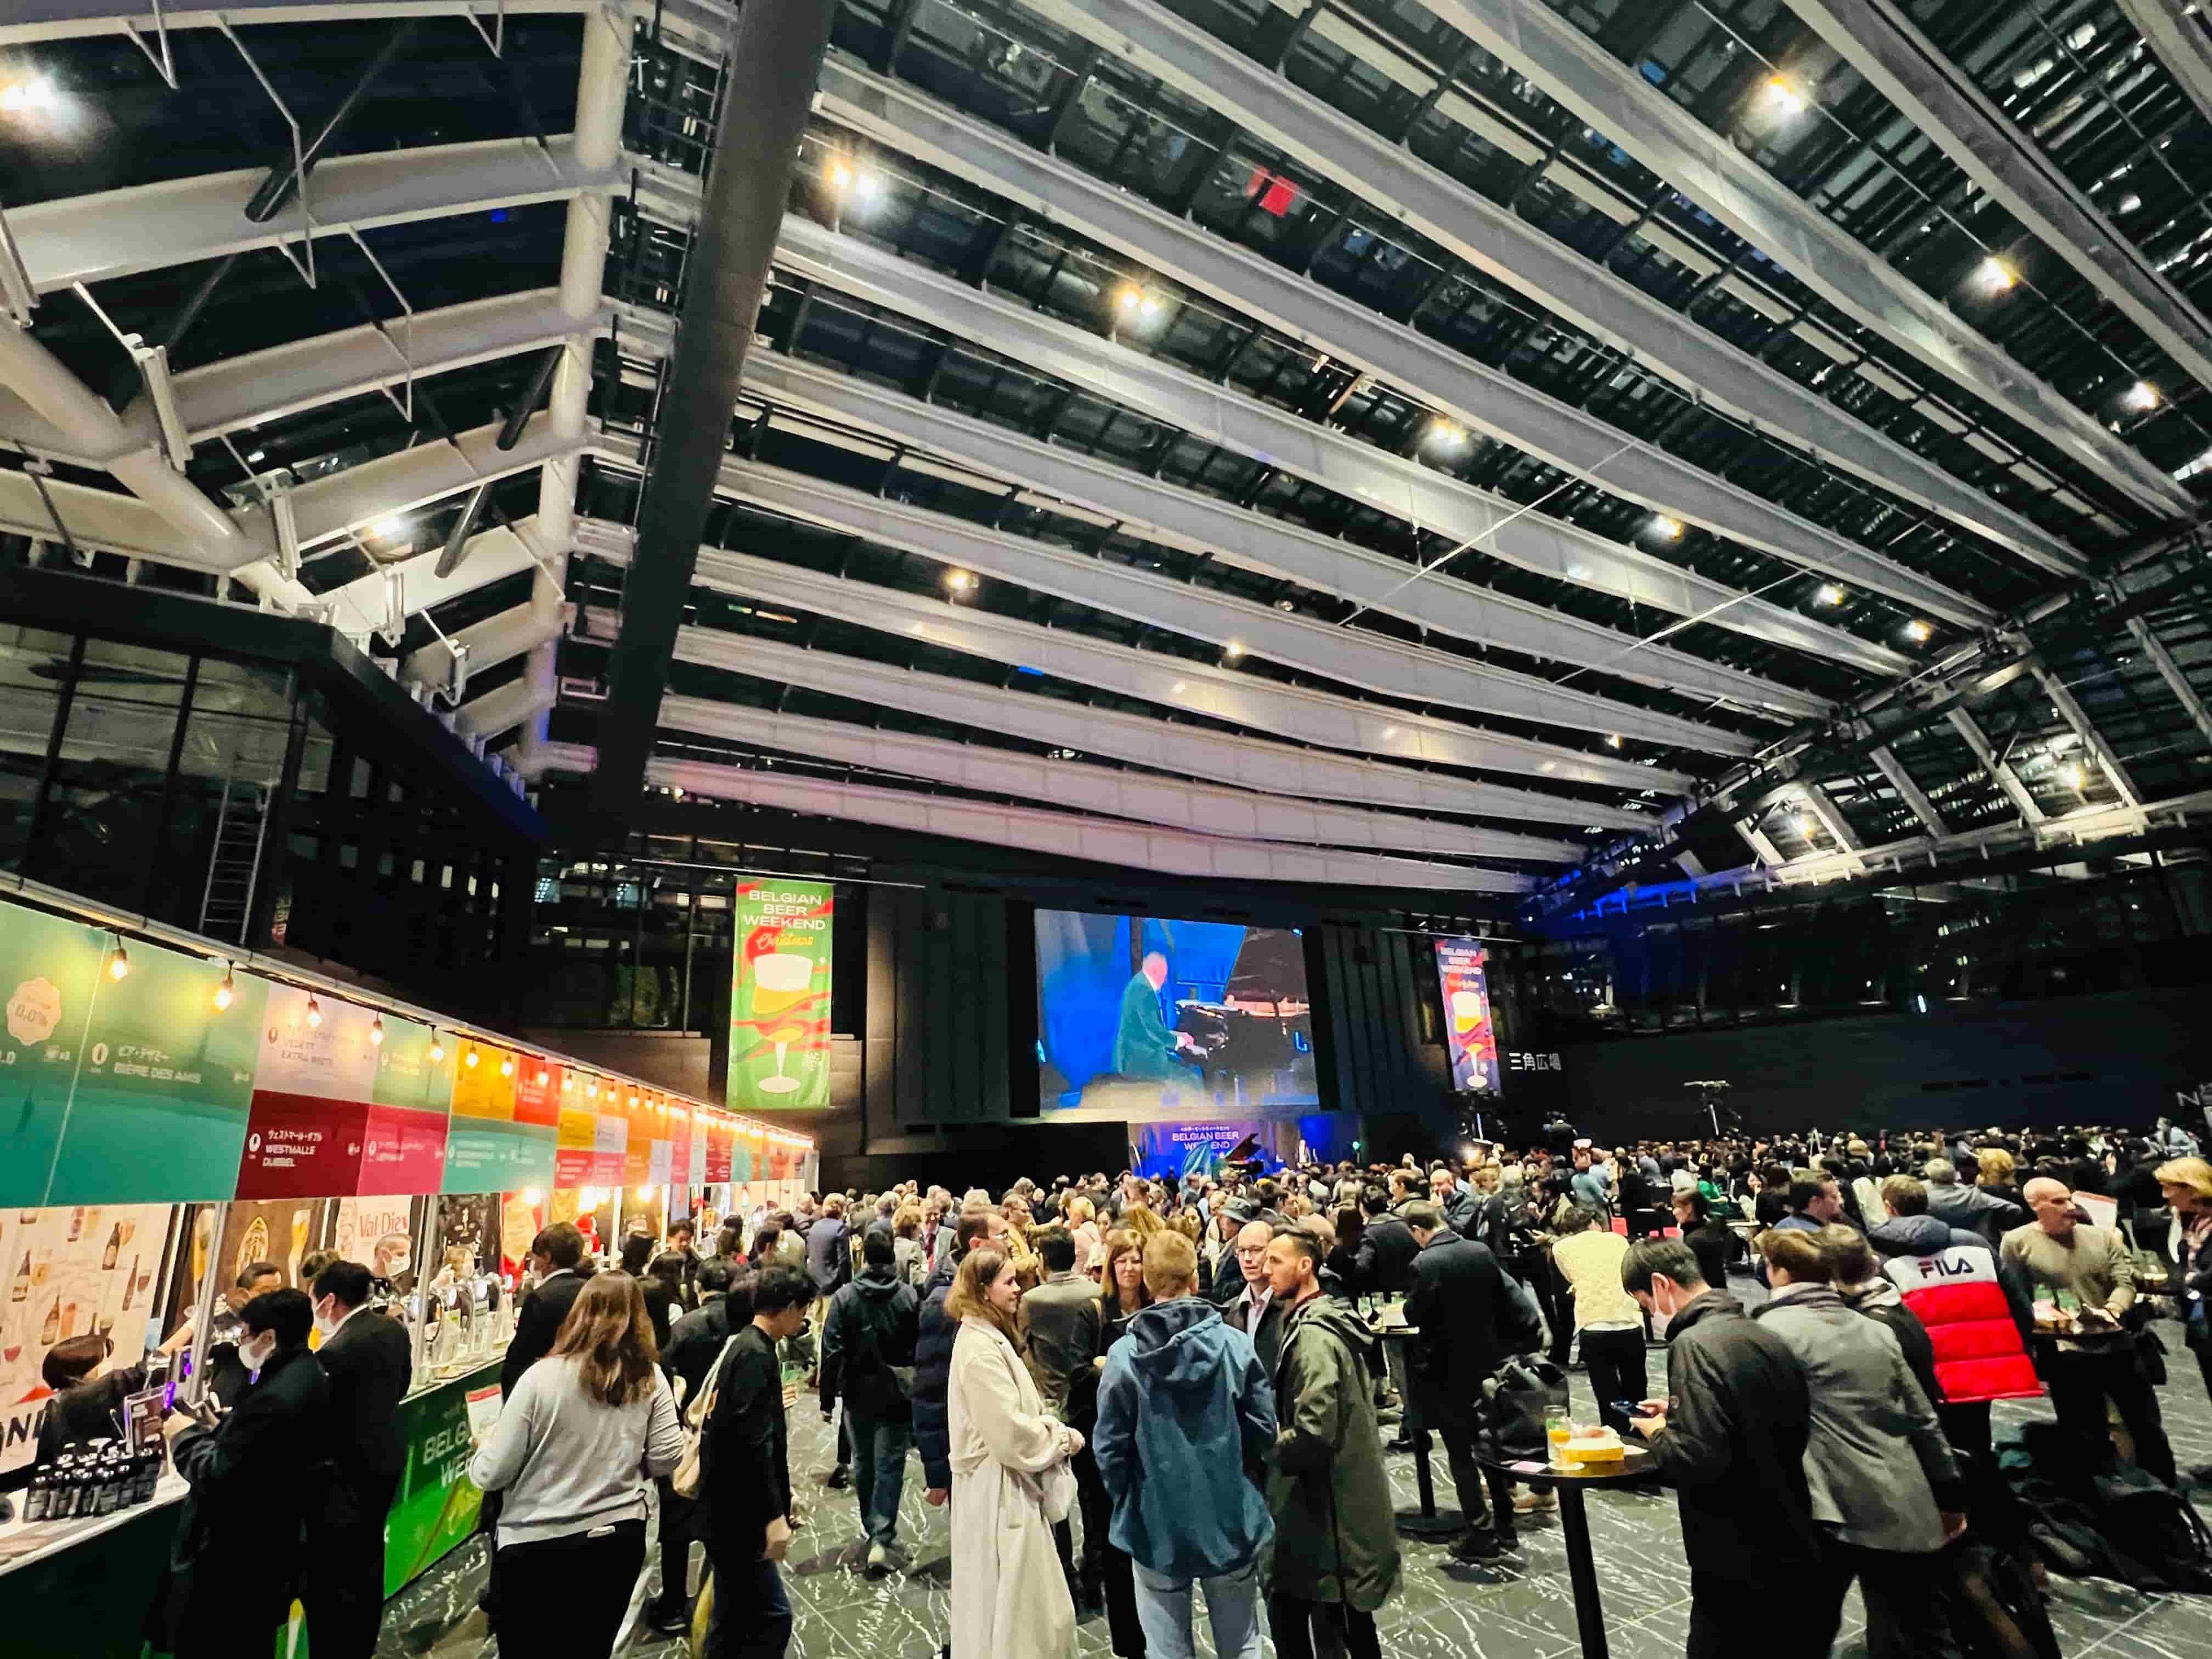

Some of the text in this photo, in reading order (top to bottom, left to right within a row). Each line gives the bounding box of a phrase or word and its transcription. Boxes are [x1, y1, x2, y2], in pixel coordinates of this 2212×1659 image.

[749, 889, 822, 905] BELGIAN
[763, 904, 808, 917] BEER
[743, 914, 826, 930] WEEKEND
[1509, 1052, 1561, 1071] 三角広場
[1172, 1130, 1239, 1142] BELGIAN BEER
[265, 1145, 316, 1155] WESTMALLE
[1184, 1141, 1230, 1151] WEEND
[1918, 1256, 1974, 1278] FILA
[423, 1420, 470, 1466] BELG
